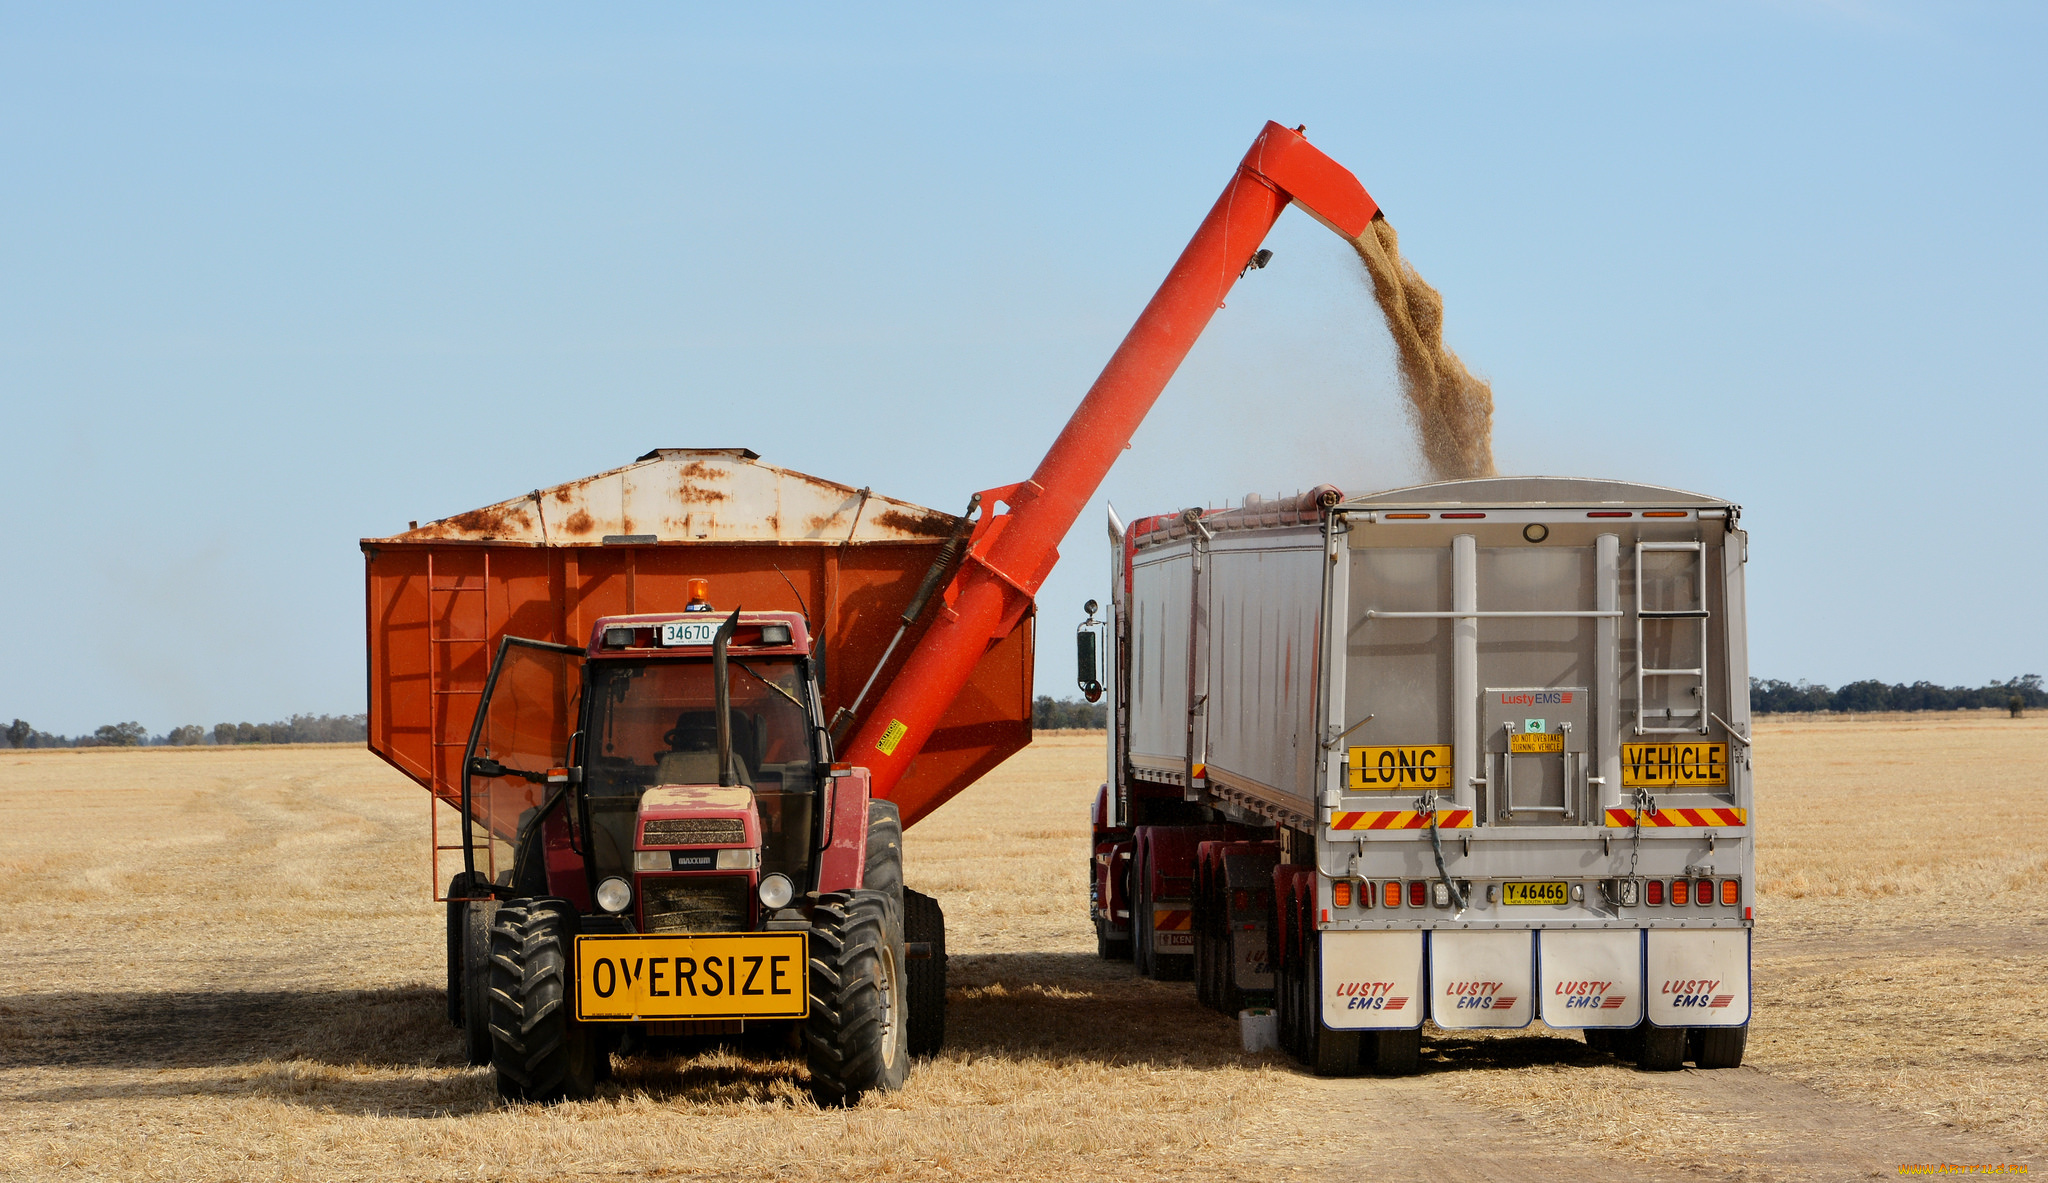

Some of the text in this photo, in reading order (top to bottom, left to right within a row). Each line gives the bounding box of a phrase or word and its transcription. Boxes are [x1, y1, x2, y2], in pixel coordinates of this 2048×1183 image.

[876, 719, 898, 749] CAUTION
[1521, 734, 1531, 742] NOT
[1533, 734, 1561, 742] OVERTAKE
[1511, 743, 1560, 751] TURNING VEHICLE
[1361, 749, 1437, 783] LONG
[1629, 747, 1720, 779] VEHICLE
[1173, 936, 1194, 945] KEN
[1246, 951, 1268, 963] LU
[592, 955, 792, 998] OVERSIZE
[1336, 982, 1395, 997] LUSTY
[1446, 981, 1503, 996] LUSTY
[1555, 981, 1612, 995] LUSTY
[1662, 980, 1720, 994] LUSTY
[1347, 997, 1384, 1010] EMS
[1456, 996, 1492, 1009] EMS
[1566, 995, 1602, 1008] EMS
[1673, 994, 1709, 1007] EMS
